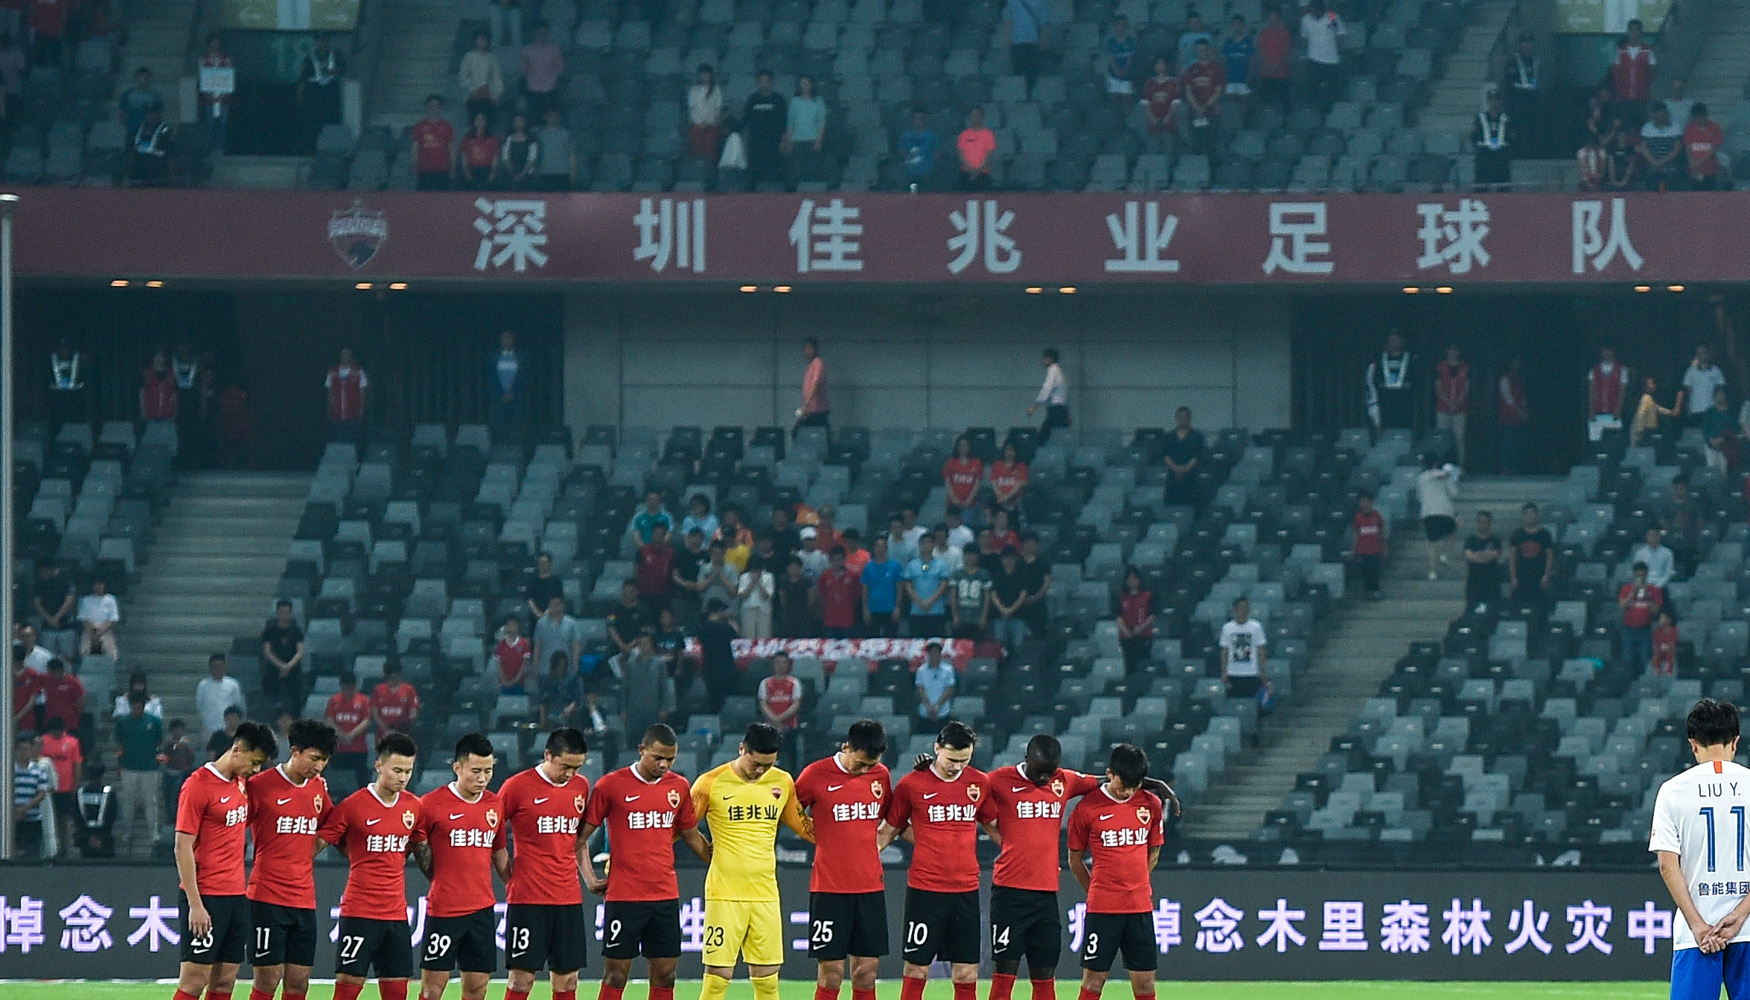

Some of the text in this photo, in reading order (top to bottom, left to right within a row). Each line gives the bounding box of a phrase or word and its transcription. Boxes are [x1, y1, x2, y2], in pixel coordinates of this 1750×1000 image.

[473, 197, 1643, 275] 深圳佳兆业足球队
[1698, 781, 1741, 798] LIU Y.
[627, 811, 675, 829] 佳兆业
[728, 804, 779, 821] 佳兆业
[832, 801, 881, 822] 佳兆业
[928, 804, 978, 823] 佳兆业
[1016, 801, 1063, 819] 佳兆业
[537, 816, 580, 834] 佳兆业
[366, 834, 409, 853] 佳兆业
[450, 829, 495, 848] 佳兆业
[1100, 827, 1149, 847] 佳兆业
[1698, 805, 1746, 873] 11
[1697, 881, 1750, 897] 鲁能集团
[256, 927, 271, 950] 11
[512, 927, 530, 950] 13
[610, 919, 622, 942] 9
[705, 925, 725, 947] 23
[811, 919, 834, 943] 25
[906, 921, 928, 945] 10
[992, 924, 1010, 947] 14
[341, 936, 365, 958] 27
[427, 932, 452, 957] 39
[1087, 932, 1099, 955] 3
